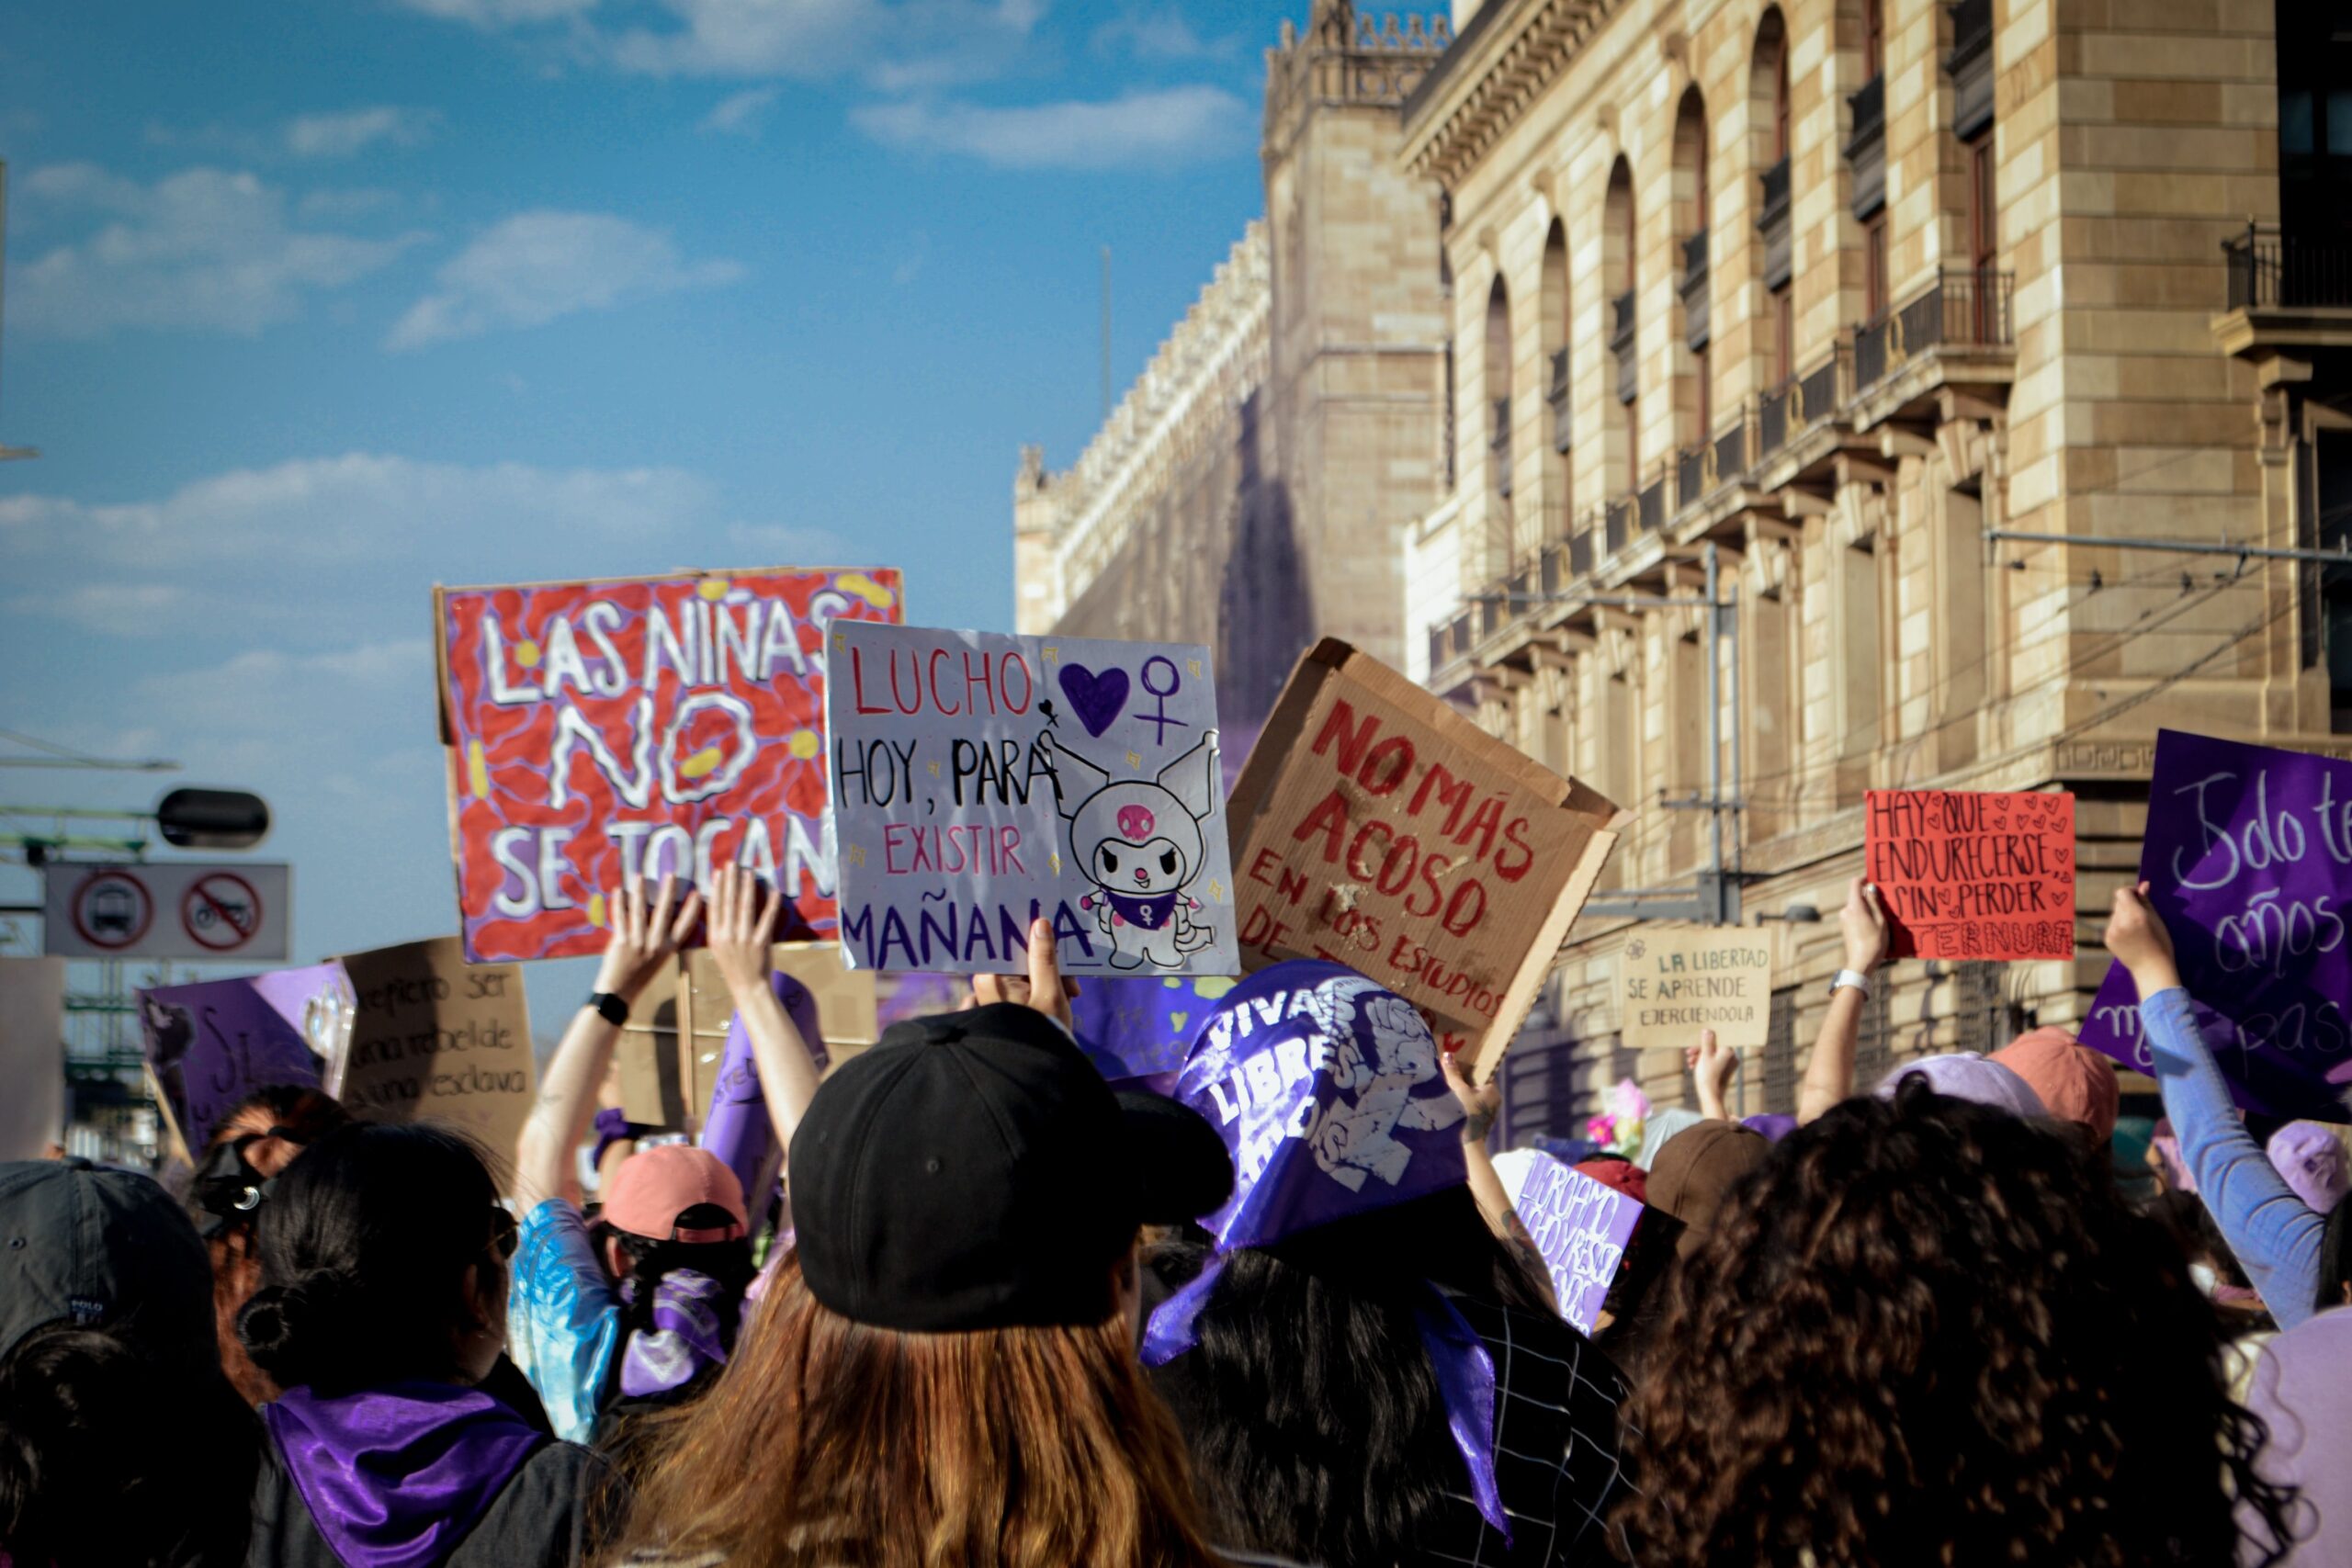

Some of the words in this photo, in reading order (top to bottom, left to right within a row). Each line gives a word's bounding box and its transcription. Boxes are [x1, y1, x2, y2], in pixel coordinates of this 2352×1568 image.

[483, 601, 627, 705] LAS
[851, 647, 1034, 716] LUCHO
[549, 691, 757, 810] NO
[838, 739, 935, 816] HOY,
[952, 739, 1065, 807] PARA
[1311, 699, 1416, 796] NO
[1407, 763, 1535, 884] MÁS
[1872, 792, 1929, 838] HAY
[1942, 792, 1990, 834] QUE
[491, 825, 573, 917] SE
[884, 823, 1025, 876] EXISTIR
[1292, 788, 1487, 938] ACOSO
[841, 888, 1094, 971] MAÑANA
[1894, 886, 1939, 919] SIN
[1958, 881, 2047, 919] PERDER
[1238, 902, 1294, 963] DE
[1249, 847, 1309, 906] EN
[1318, 887, 1384, 953] LOS
[1387, 933, 1508, 1019] ESTUDIOS
[1657, 953, 1686, 974] LA
[1692, 947, 1770, 972] LIBERTAD
[1907, 919, 2075, 957] TERNURA
[2215, 886, 2345, 979] años
[467, 971, 512, 1000] ser
[1627, 978, 1647, 999] SE
[1657, 976, 1747, 1001] APRENDE
[406, 1018, 516, 1057] rebelde
[1207, 988, 1358, 1052] VIVAS
[431, 1064, 527, 1098] esclava
